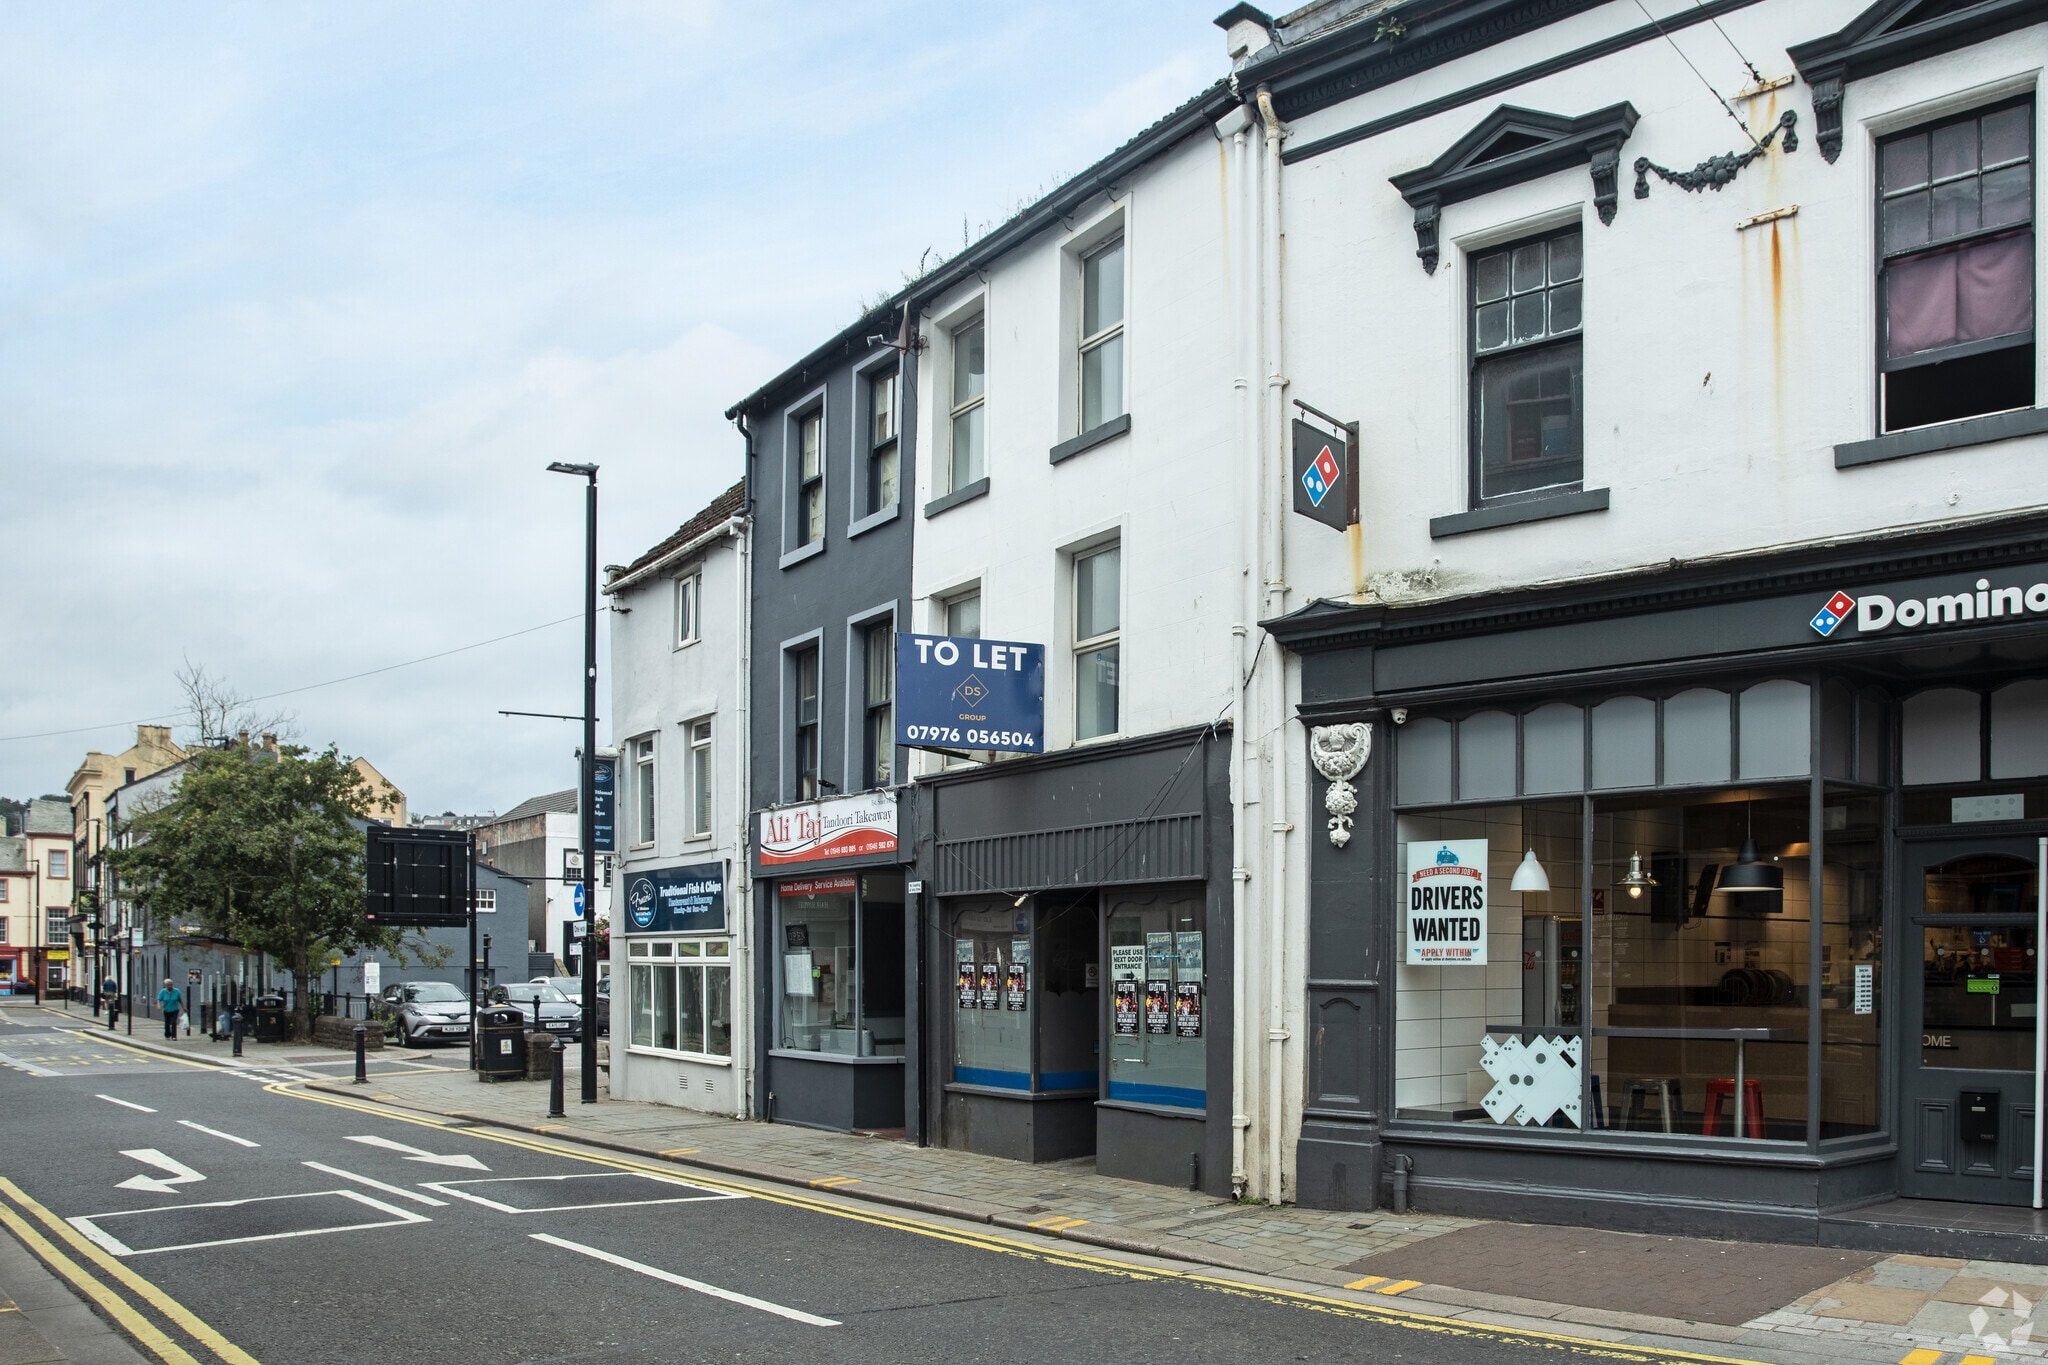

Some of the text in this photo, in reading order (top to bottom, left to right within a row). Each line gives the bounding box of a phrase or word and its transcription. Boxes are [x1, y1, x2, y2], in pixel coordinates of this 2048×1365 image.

[914, 638, 1028, 672] TO LET
[964, 685, 981, 697] DS
[958, 713, 987, 722] GROUP
[907, 724, 1035, 747] 07976 056504
[765, 809, 822, 846] Ali Taj
[822, 809, 893, 829] Tandoori Takeaway
[1419, 868, 1433, 877] NEED
[1460, 868, 1474, 876] JOB?
[660, 880, 721, 897] Traditional Fish & Chips
[780, 878, 855, 892] Home Delivery Service Available
[1411, 885, 1483, 910] DRIVERS
[1412, 917, 1480, 941] WANTED
[1421, 948, 1472, 957] APPLY WITHIN
